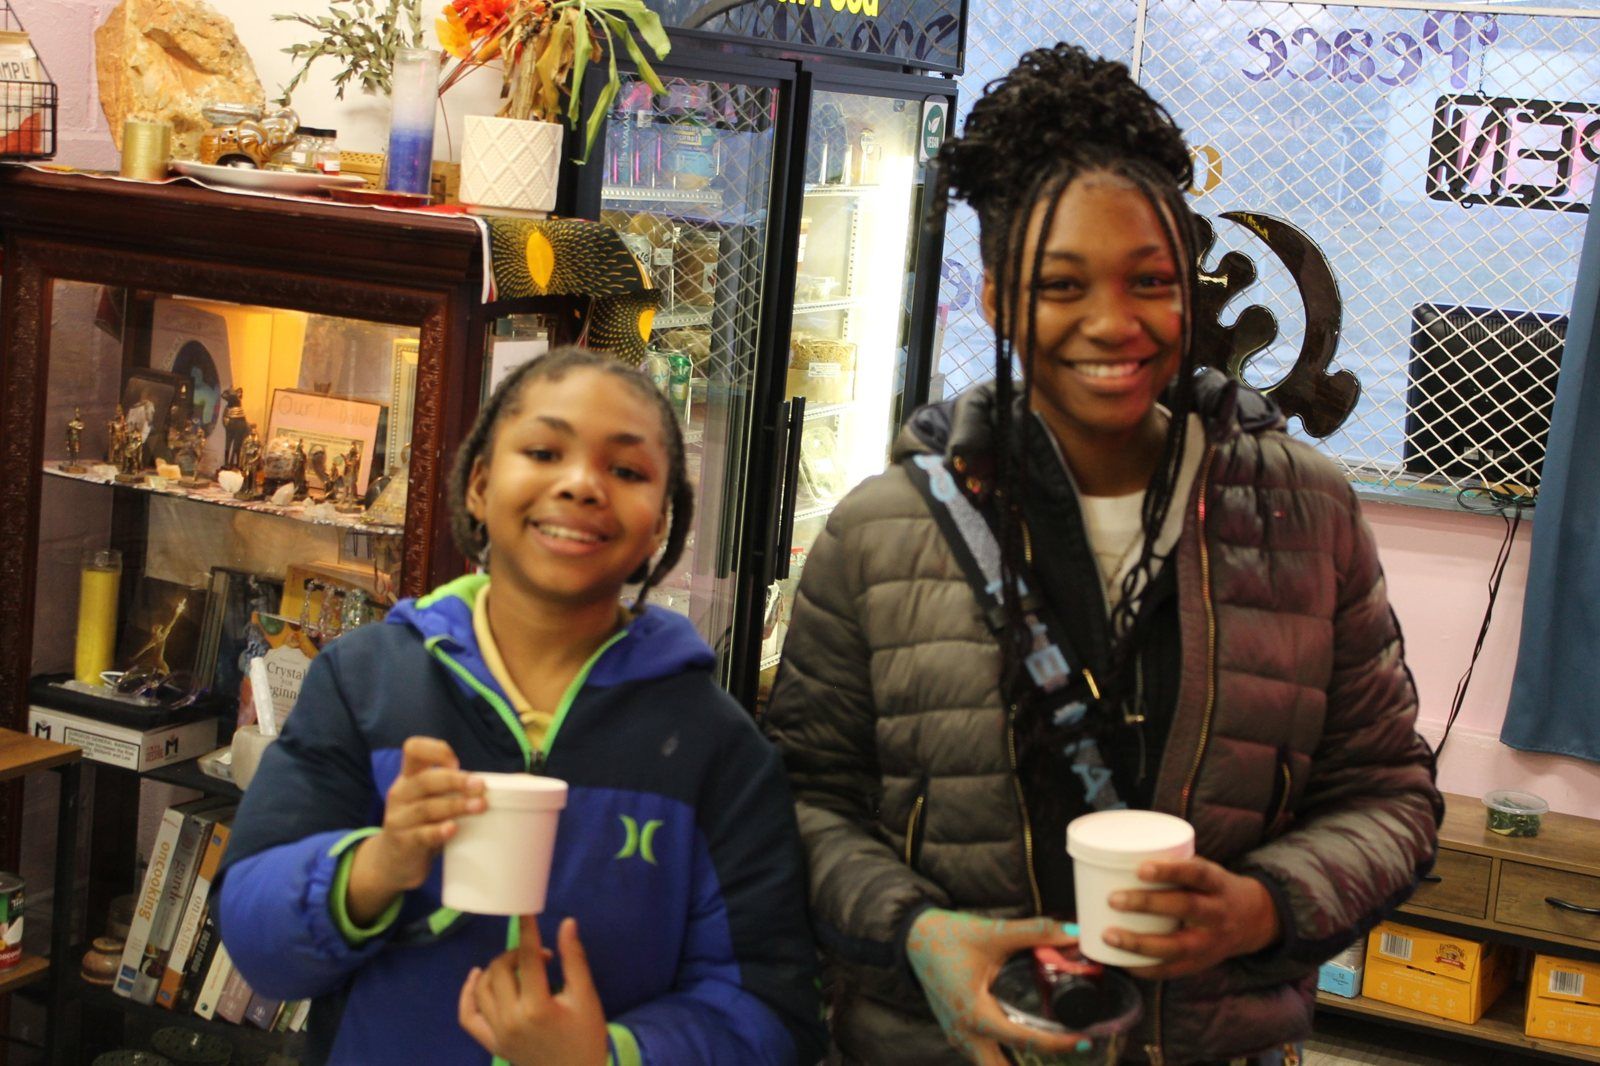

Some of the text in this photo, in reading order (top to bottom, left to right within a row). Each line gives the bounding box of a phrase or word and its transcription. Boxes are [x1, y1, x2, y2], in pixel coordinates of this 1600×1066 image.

[279, 395, 314, 416] Our
[266, 661, 307, 680] Crystal
[138, 841, 171, 921] oncooking
